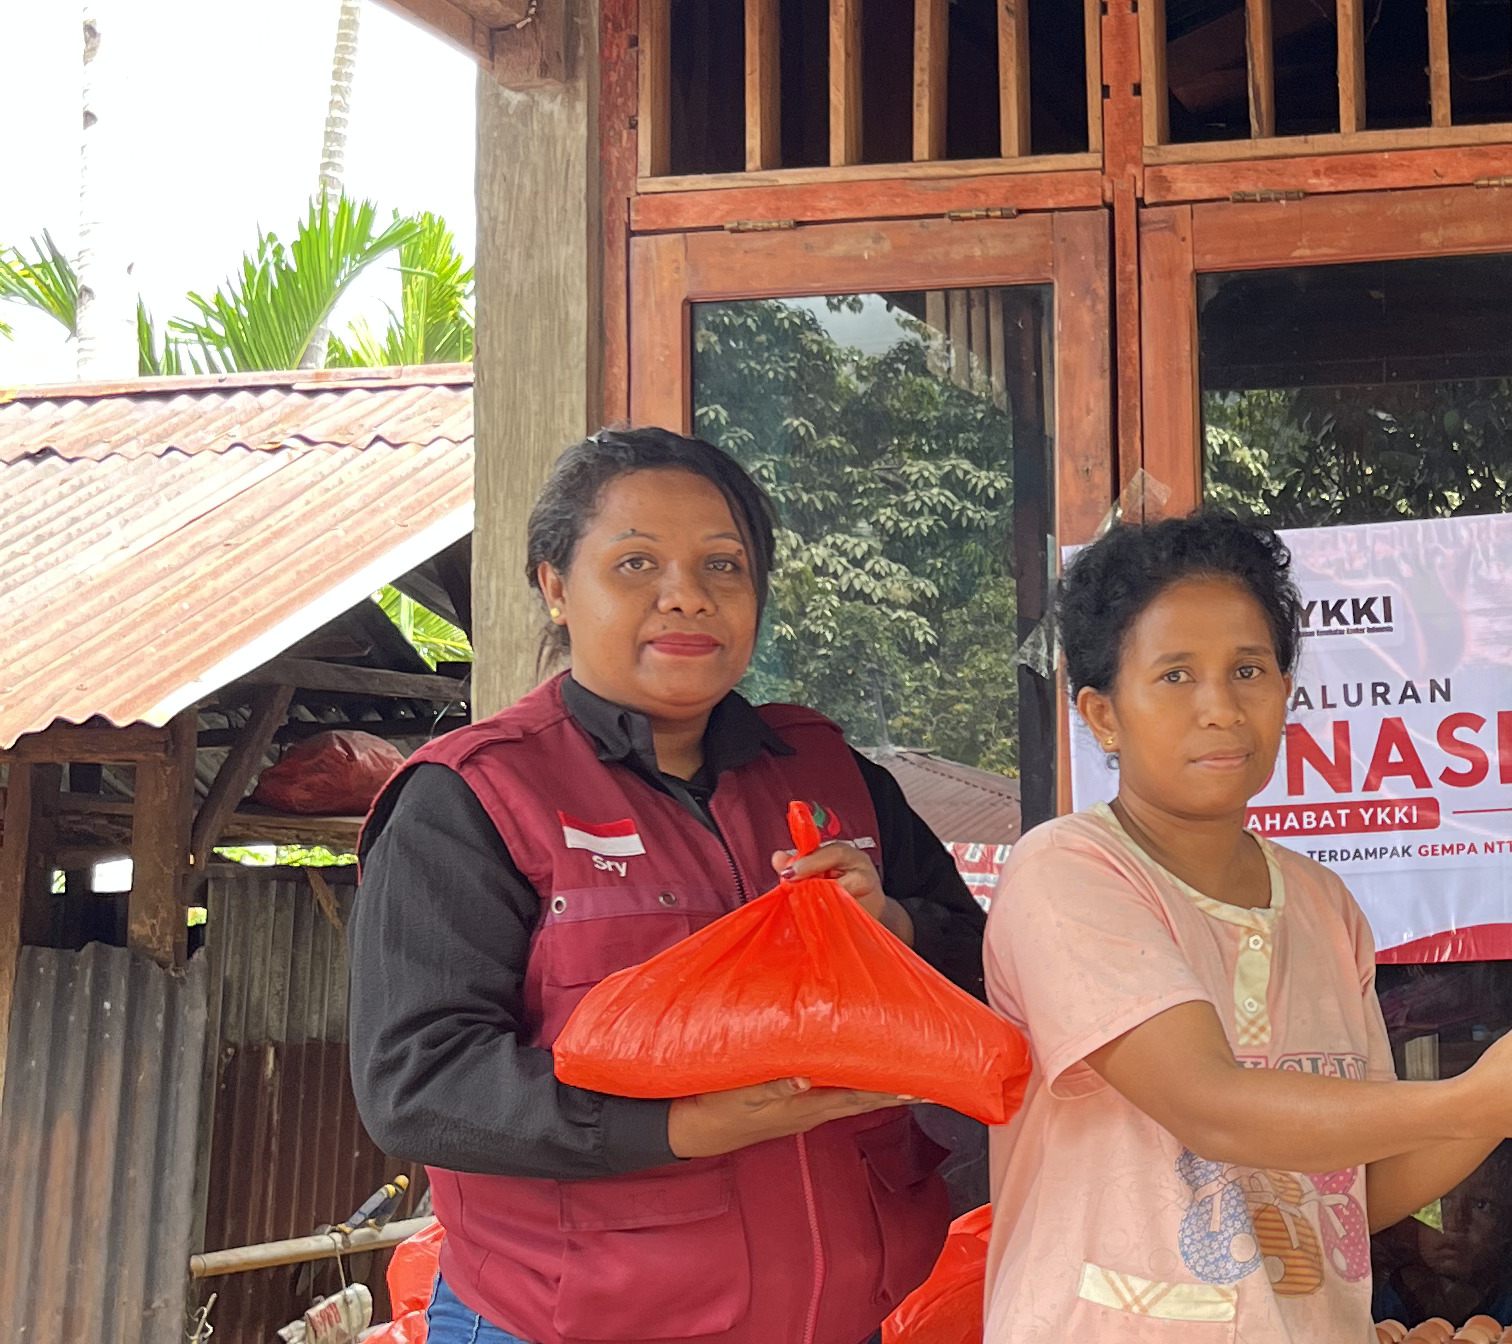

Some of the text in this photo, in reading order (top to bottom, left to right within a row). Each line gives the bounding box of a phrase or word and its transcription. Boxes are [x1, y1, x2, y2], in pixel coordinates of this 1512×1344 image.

[1300, 596, 1393, 627] YKKI
[1291, 678, 1452, 711] ALURAN
[1247, 805, 1418, 832] AHABAT YKKI
[1307, 844, 1413, 863] TERDAMPAK
[1417, 841, 1478, 857] GEMPA
